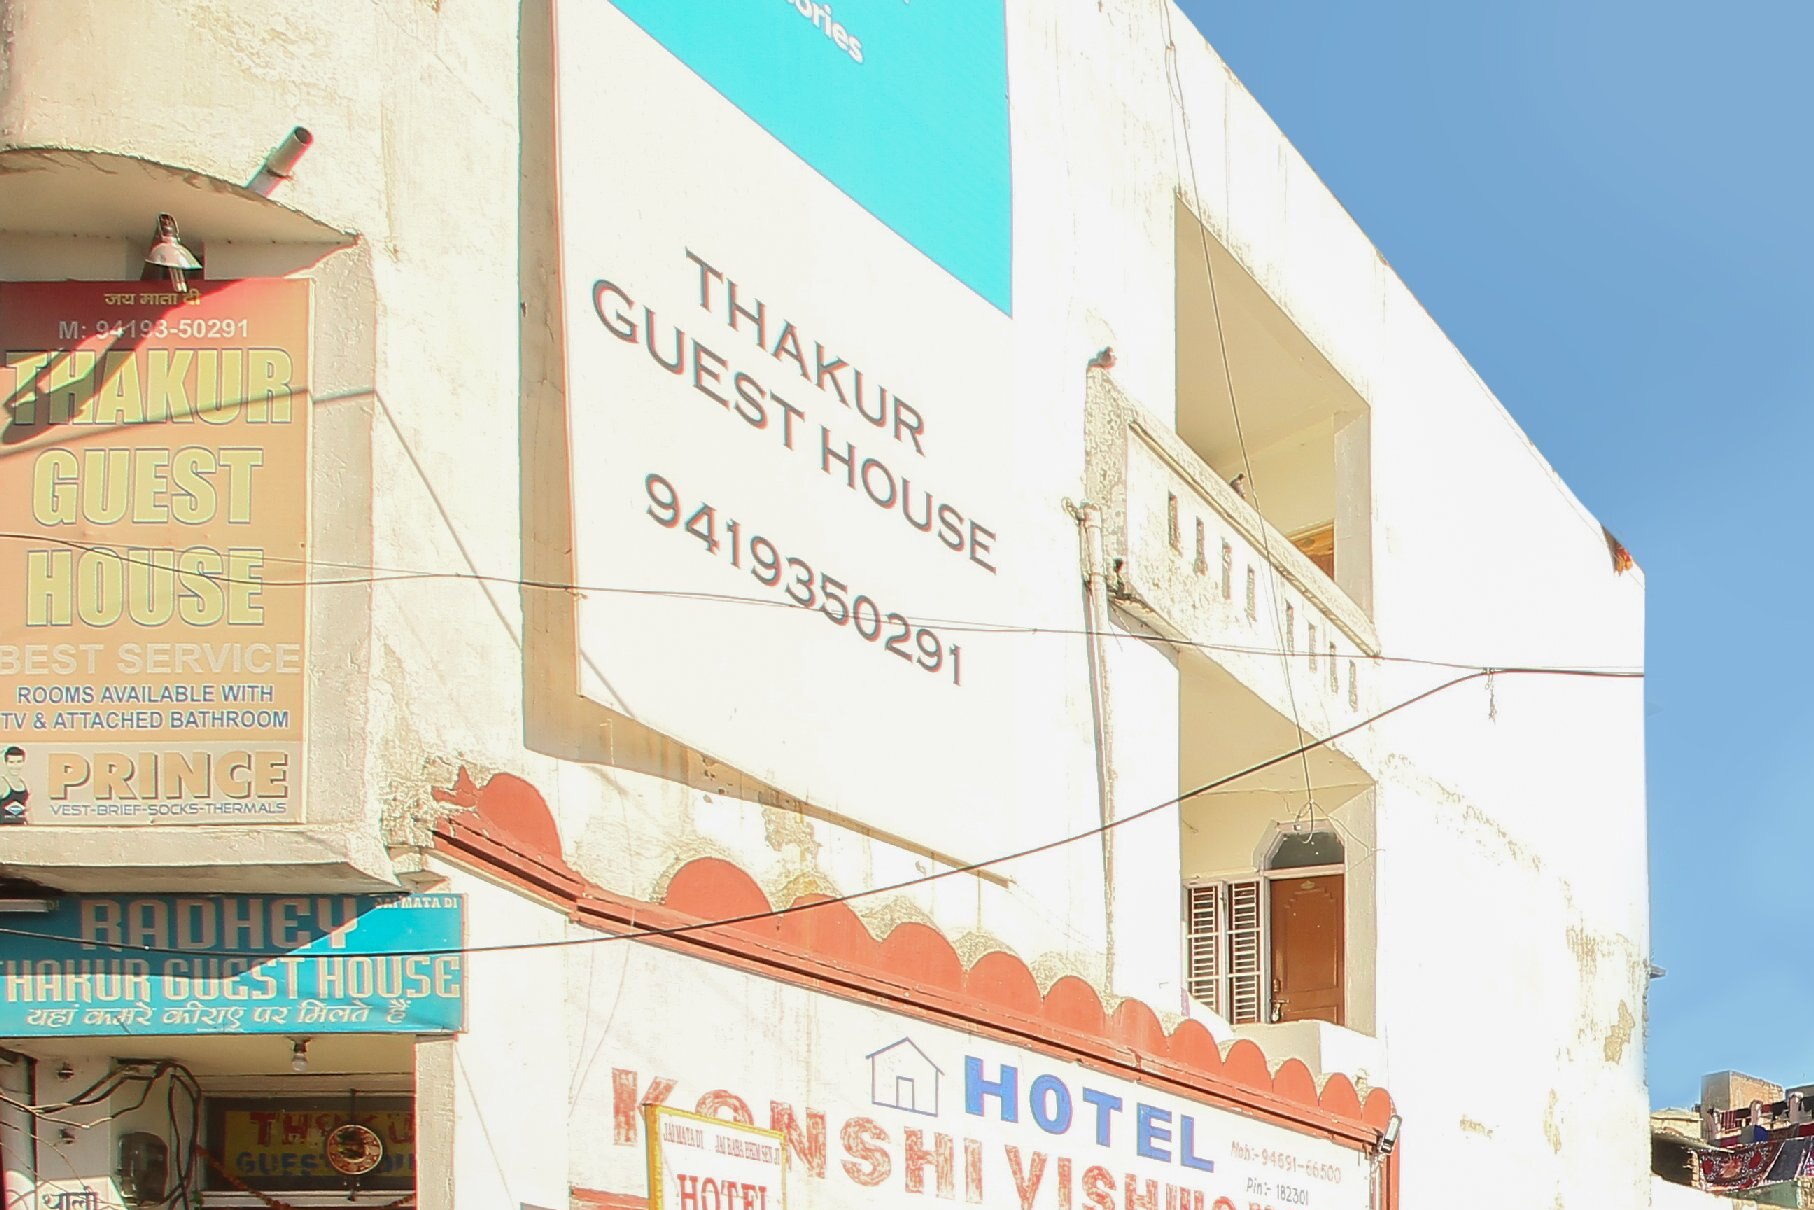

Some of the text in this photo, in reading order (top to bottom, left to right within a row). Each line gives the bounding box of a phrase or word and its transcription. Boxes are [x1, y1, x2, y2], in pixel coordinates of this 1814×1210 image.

[785, 0, 864, 64] ories
[104, 292, 136, 306] जय
[140, 292, 178, 306] माता
[95, 318, 249, 340] 94193-50291
[684, 246, 927, 456] THAKUR
[4, 347, 294, 426] THAKUR
[592, 278, 998, 576] GUEST HOUSE
[32, 446, 264, 527] GUEST
[26, 547, 266, 628] HOUSE
[644, 473, 963, 686] 9419350291
[0, 642, 301, 676] BEST SERVICE
[1, 711, 289, 729] TV & ATTACHED BATHROOM
[18, 685, 274, 704] ROOMS AVAILABLE WITH
[49, 750, 289, 801] PRINCE
[50, 802, 287, 817] VEST-BRIEF-SOCKS-THERMALS
[80, 898, 358, 950] RADHEY
[402, 897, 441, 909] MATA
[444, 897, 458, 909] DI
[0, 955, 461, 1002] HAKUR GUEST HOUSE
[26, 1004, 80, 1027] यहां
[82, 1001, 156, 1027] कमरे
[252, 1006, 292, 1026] पर
[296, 999, 373, 1025] मिलते
[963, 1054, 1215, 1173] HOTEL
